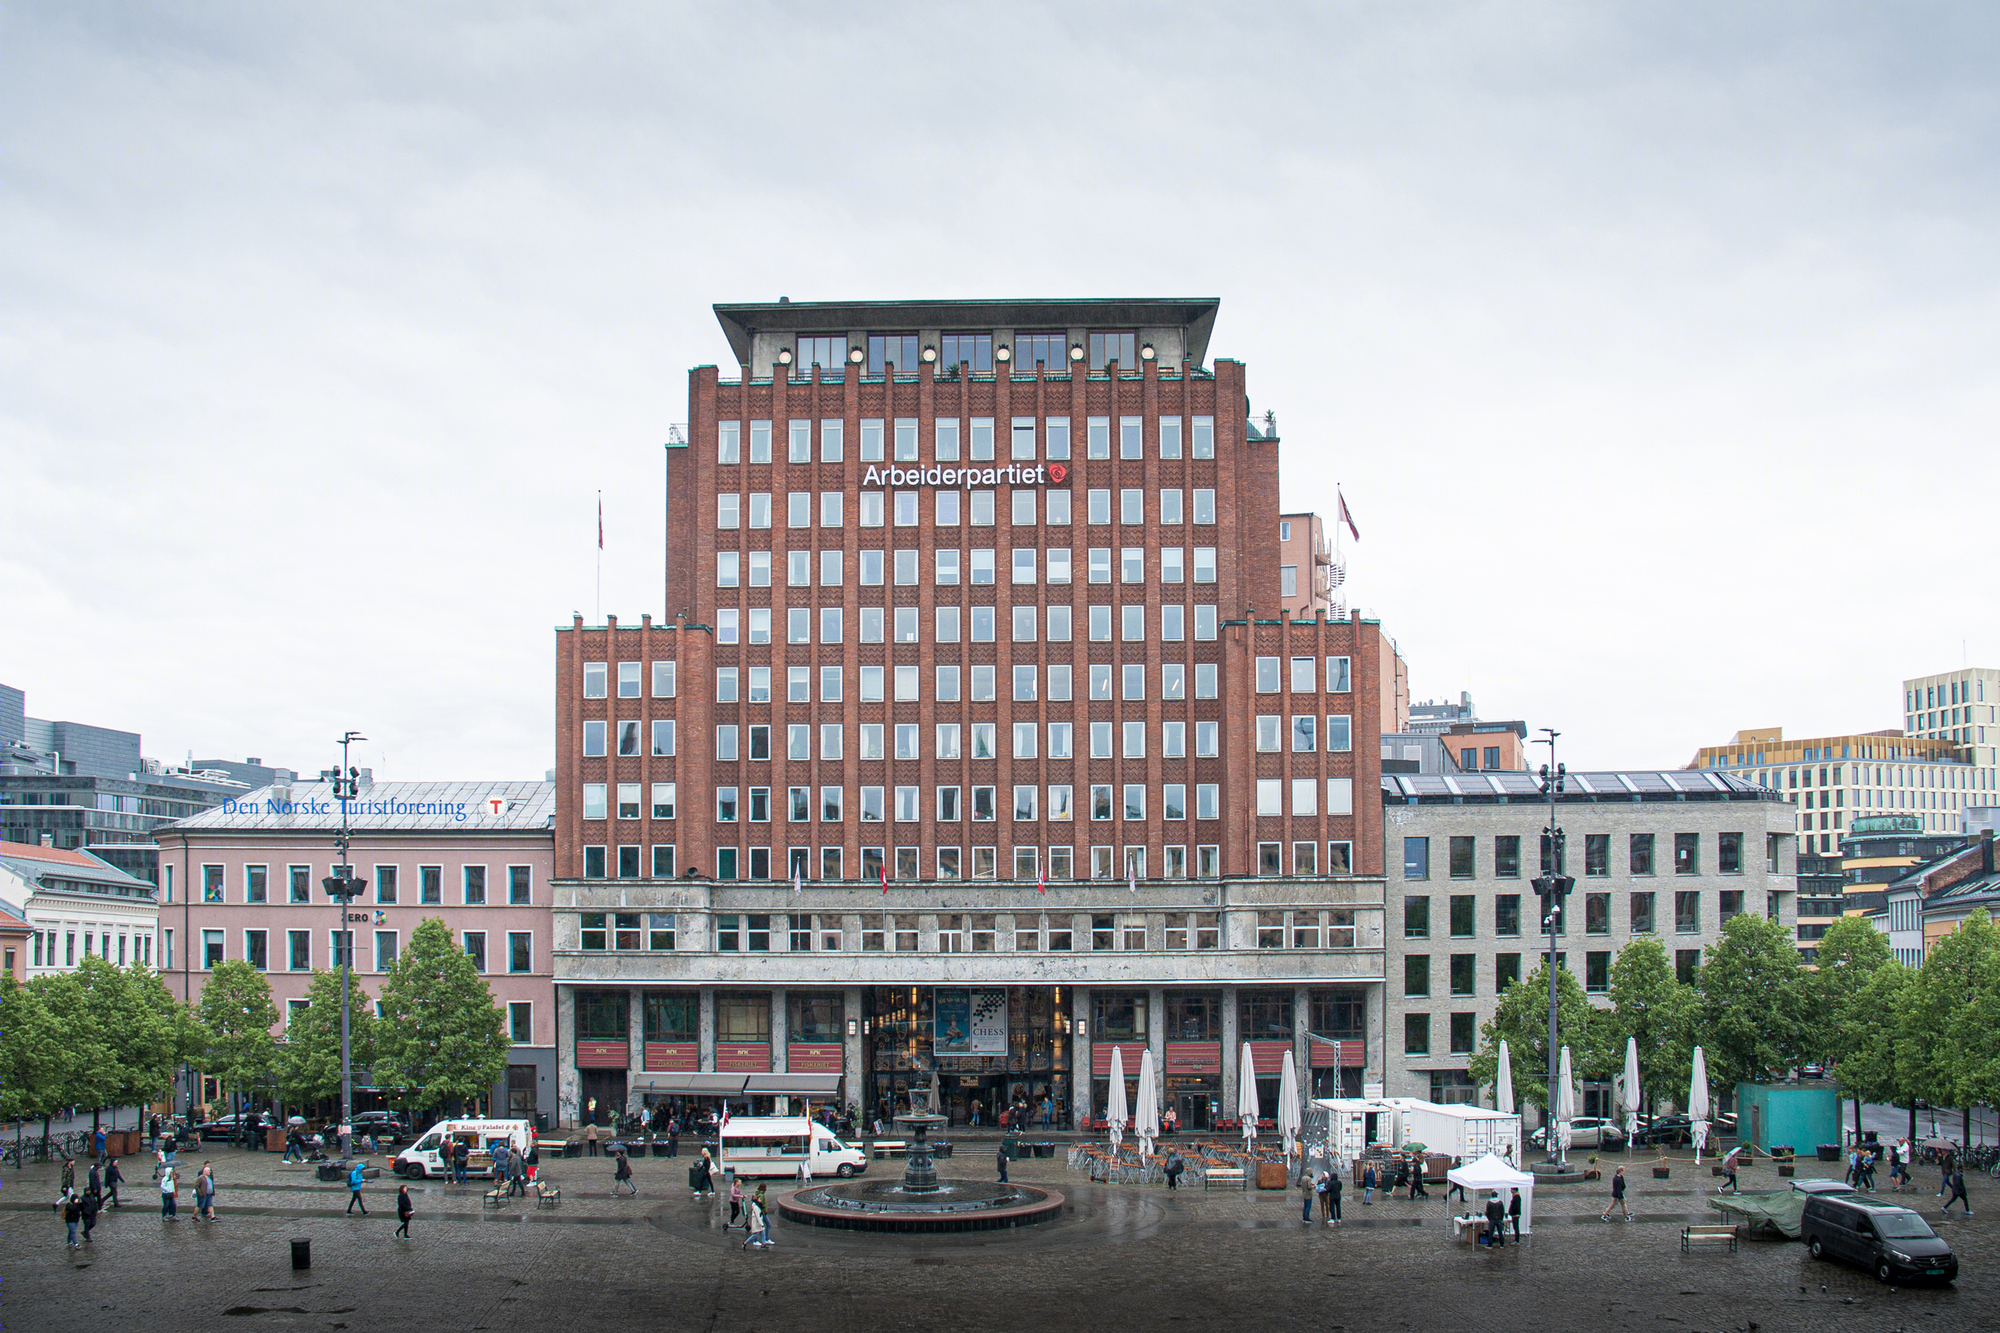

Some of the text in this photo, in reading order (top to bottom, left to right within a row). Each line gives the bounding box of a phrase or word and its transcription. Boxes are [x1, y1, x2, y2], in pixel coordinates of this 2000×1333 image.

[863, 464, 1045, 489] Arbeiderpartiet
[223, 797, 467, 821] Den Norske Turistforening
[973, 1028, 1004, 1036] CHESS
